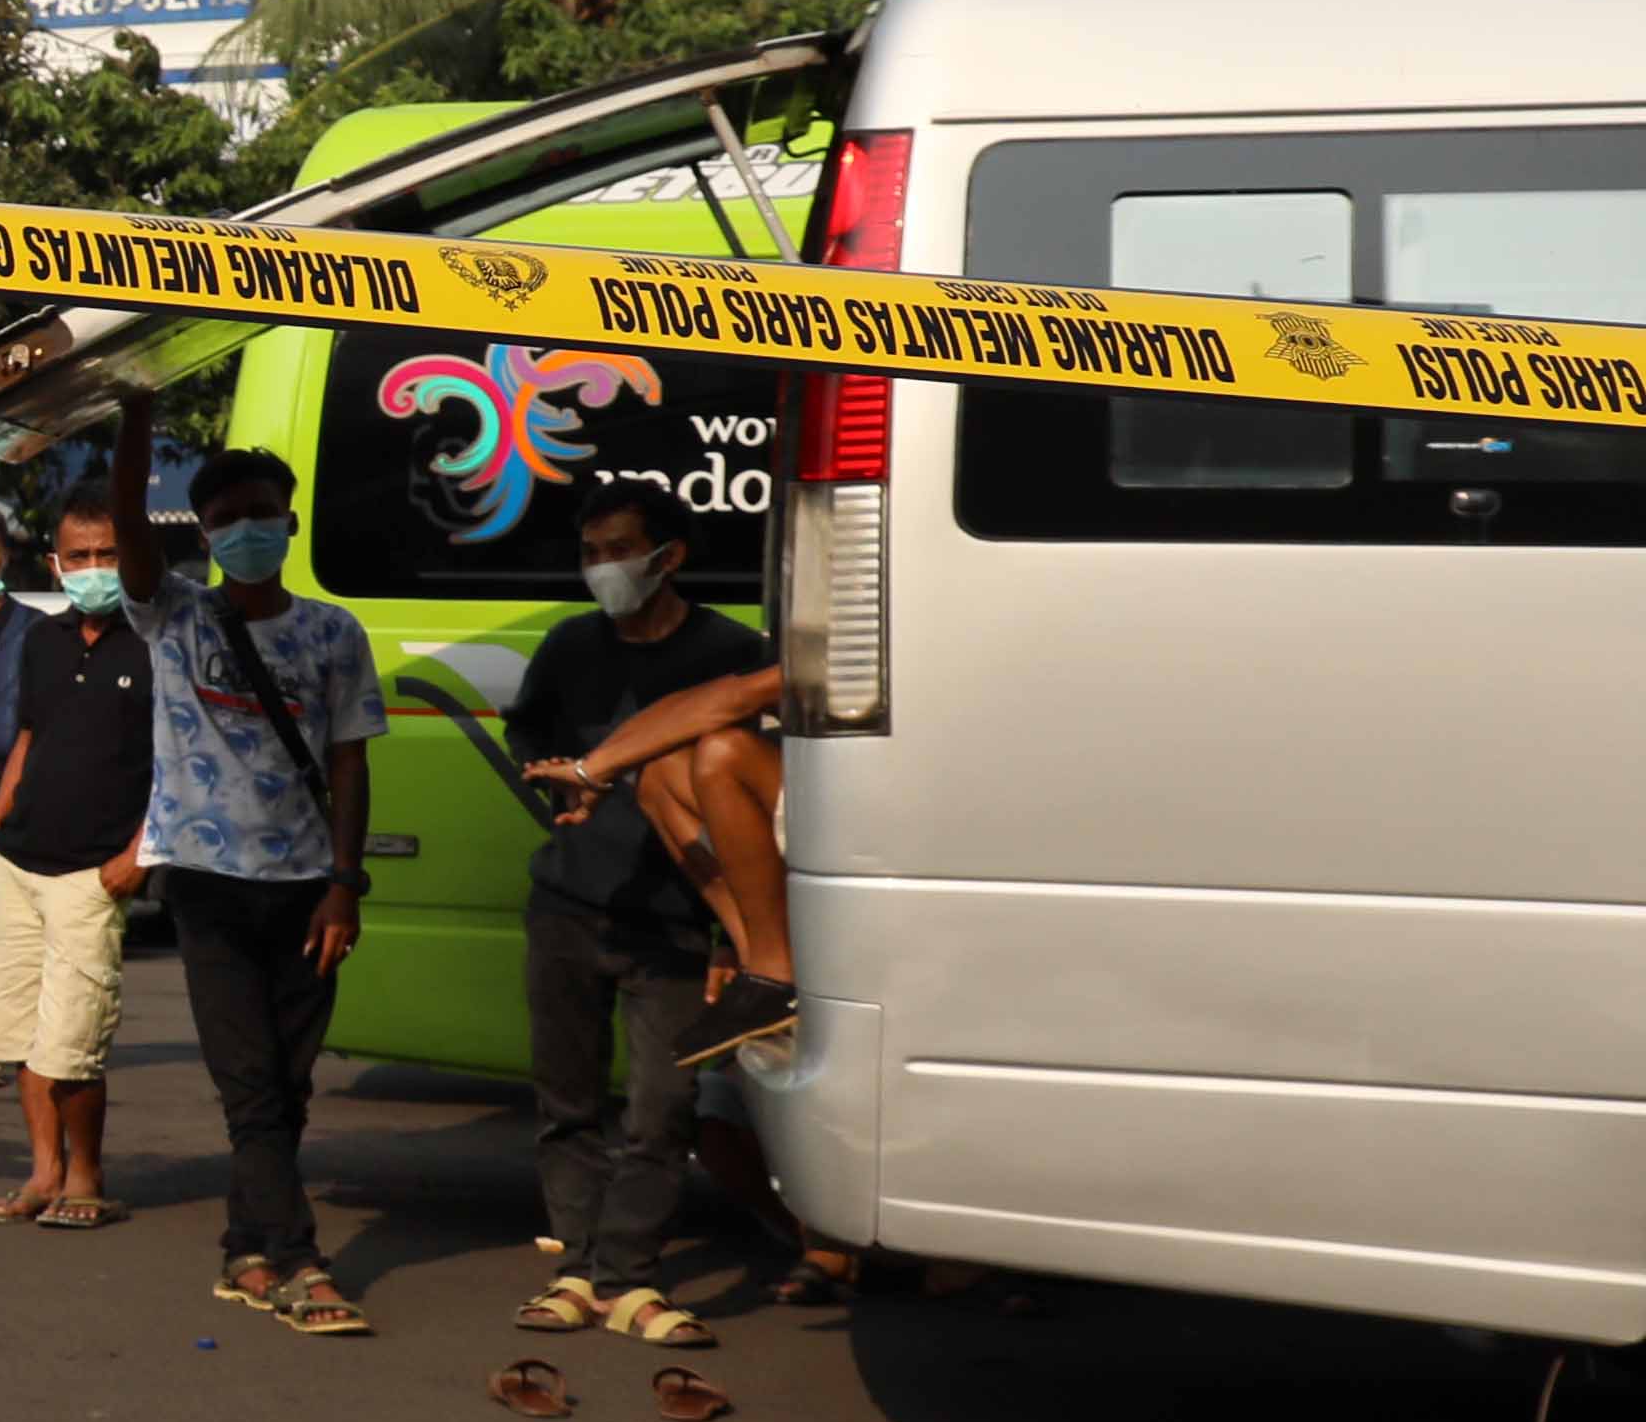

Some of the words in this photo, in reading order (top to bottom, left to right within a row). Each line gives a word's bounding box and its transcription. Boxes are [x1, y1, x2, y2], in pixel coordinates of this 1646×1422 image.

[22, 225, 221, 297] MELINTAS
[223, 243, 421, 314] DILARANG
[615, 255, 672, 276] LINE
[675, 259, 759, 284] POLICE
[934, 280, 1019, 306] CROSS
[589, 275, 720, 341] POLISI
[721, 287, 843, 352] GARIS
[1019, 287, 1071, 310] NOT
[1068, 291, 1109, 313] DO
[1410, 316, 1477, 341] LINE
[843, 297, 1042, 368] MELINTAS
[1038, 314, 1237, 384] DILARANG
[1468, 320, 1562, 348] POLICE
[1395, 343, 1531, 407] POLISI
[1526, 352, 1646, 416] GARIS
